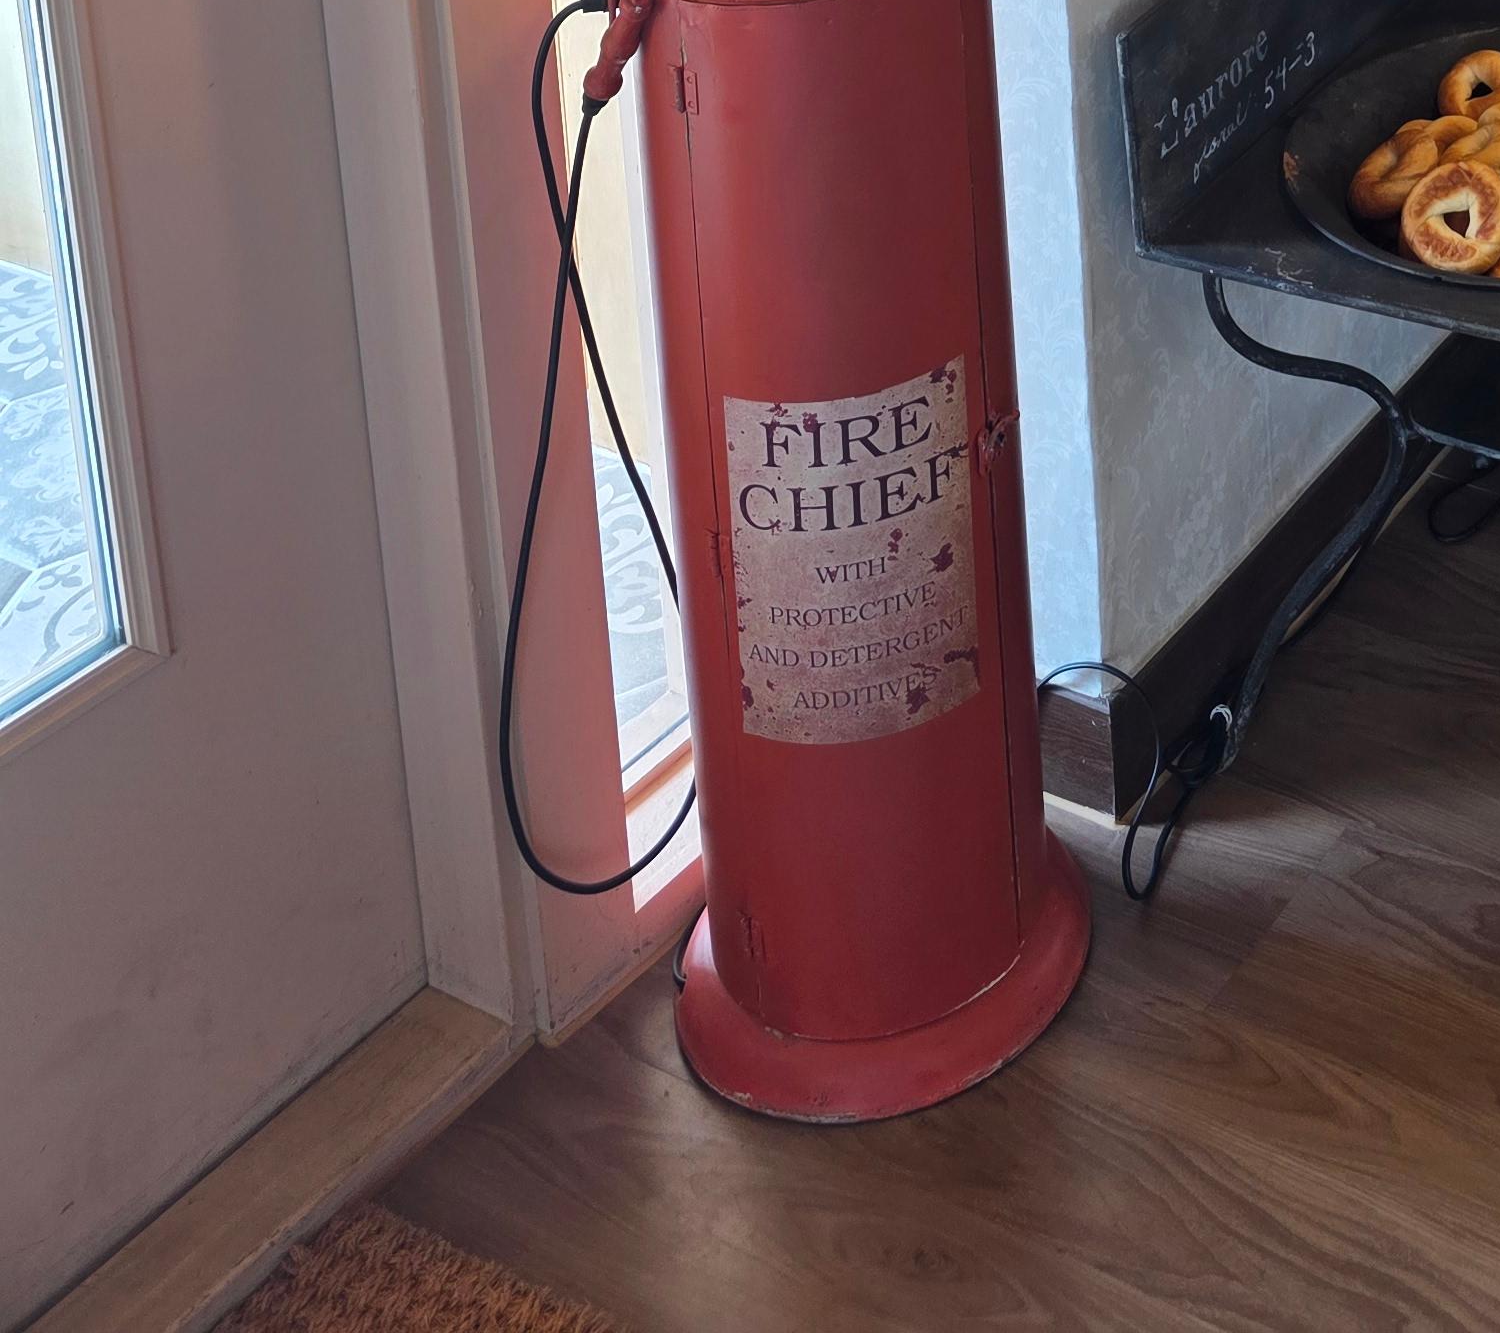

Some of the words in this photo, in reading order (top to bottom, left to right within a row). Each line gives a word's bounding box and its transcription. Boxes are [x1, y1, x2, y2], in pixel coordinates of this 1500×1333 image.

[761, 395, 933, 469] FIRE
[738, 444, 969, 532] CHIEF
[815, 556, 887, 585] WITH
[769, 580, 937, 628] PROTECTIVE
[748, 644, 800, 668] AND
[809, 604, 969, 669] DETERGENT
[792, 667, 939, 711] ADDITIVES
